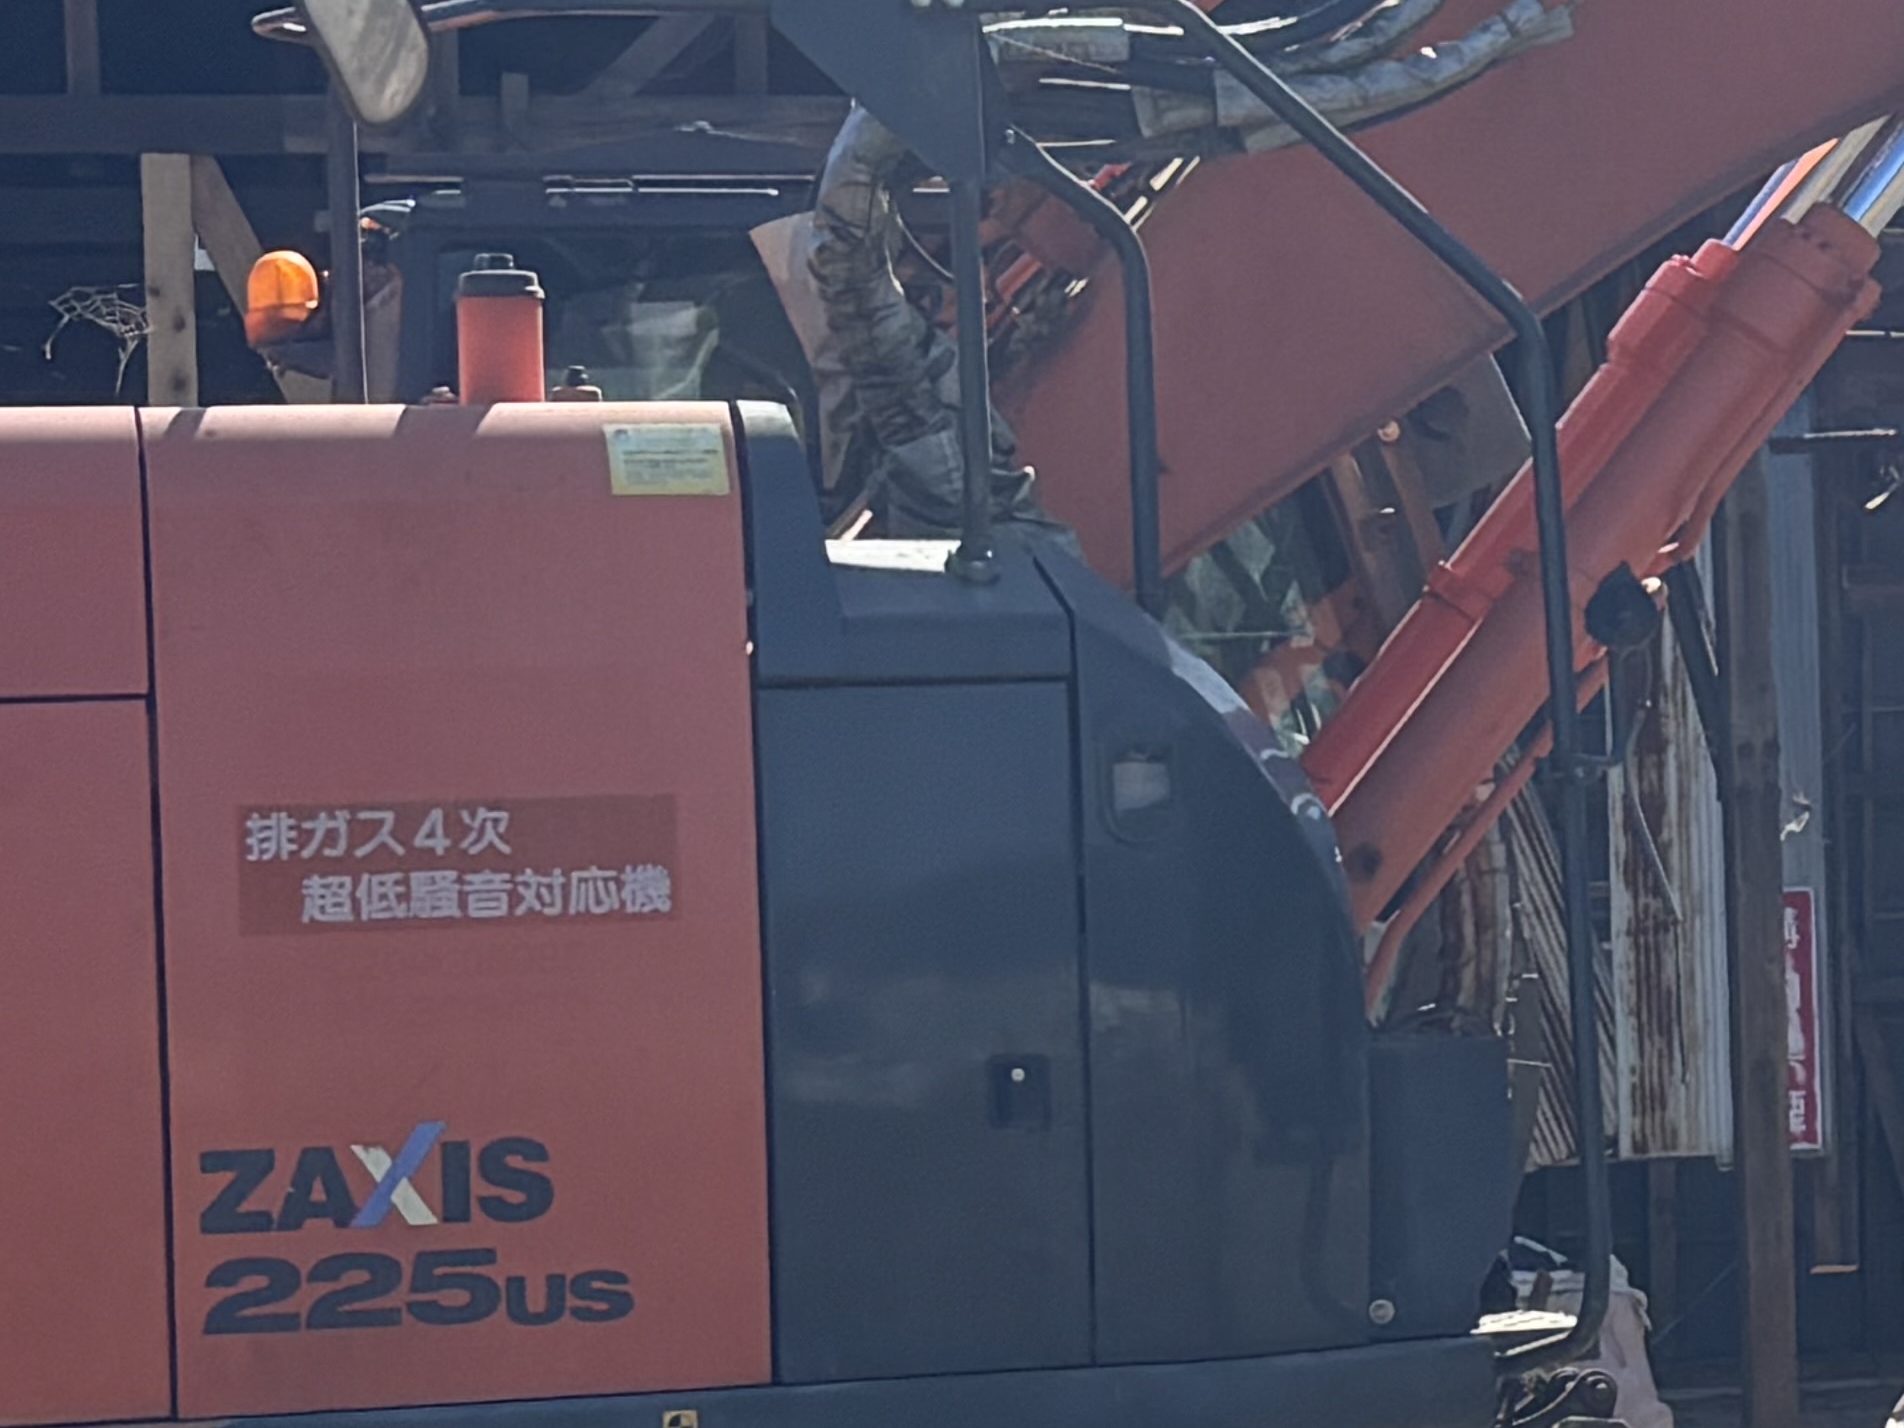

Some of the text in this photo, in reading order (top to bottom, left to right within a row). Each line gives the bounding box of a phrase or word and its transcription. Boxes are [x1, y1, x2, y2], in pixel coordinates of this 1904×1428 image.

[245, 807, 512, 861] 排ガス4次
[302, 864, 671, 923] 超低騒音対応機
[200, 1121, 555, 1234] ZAXIS
